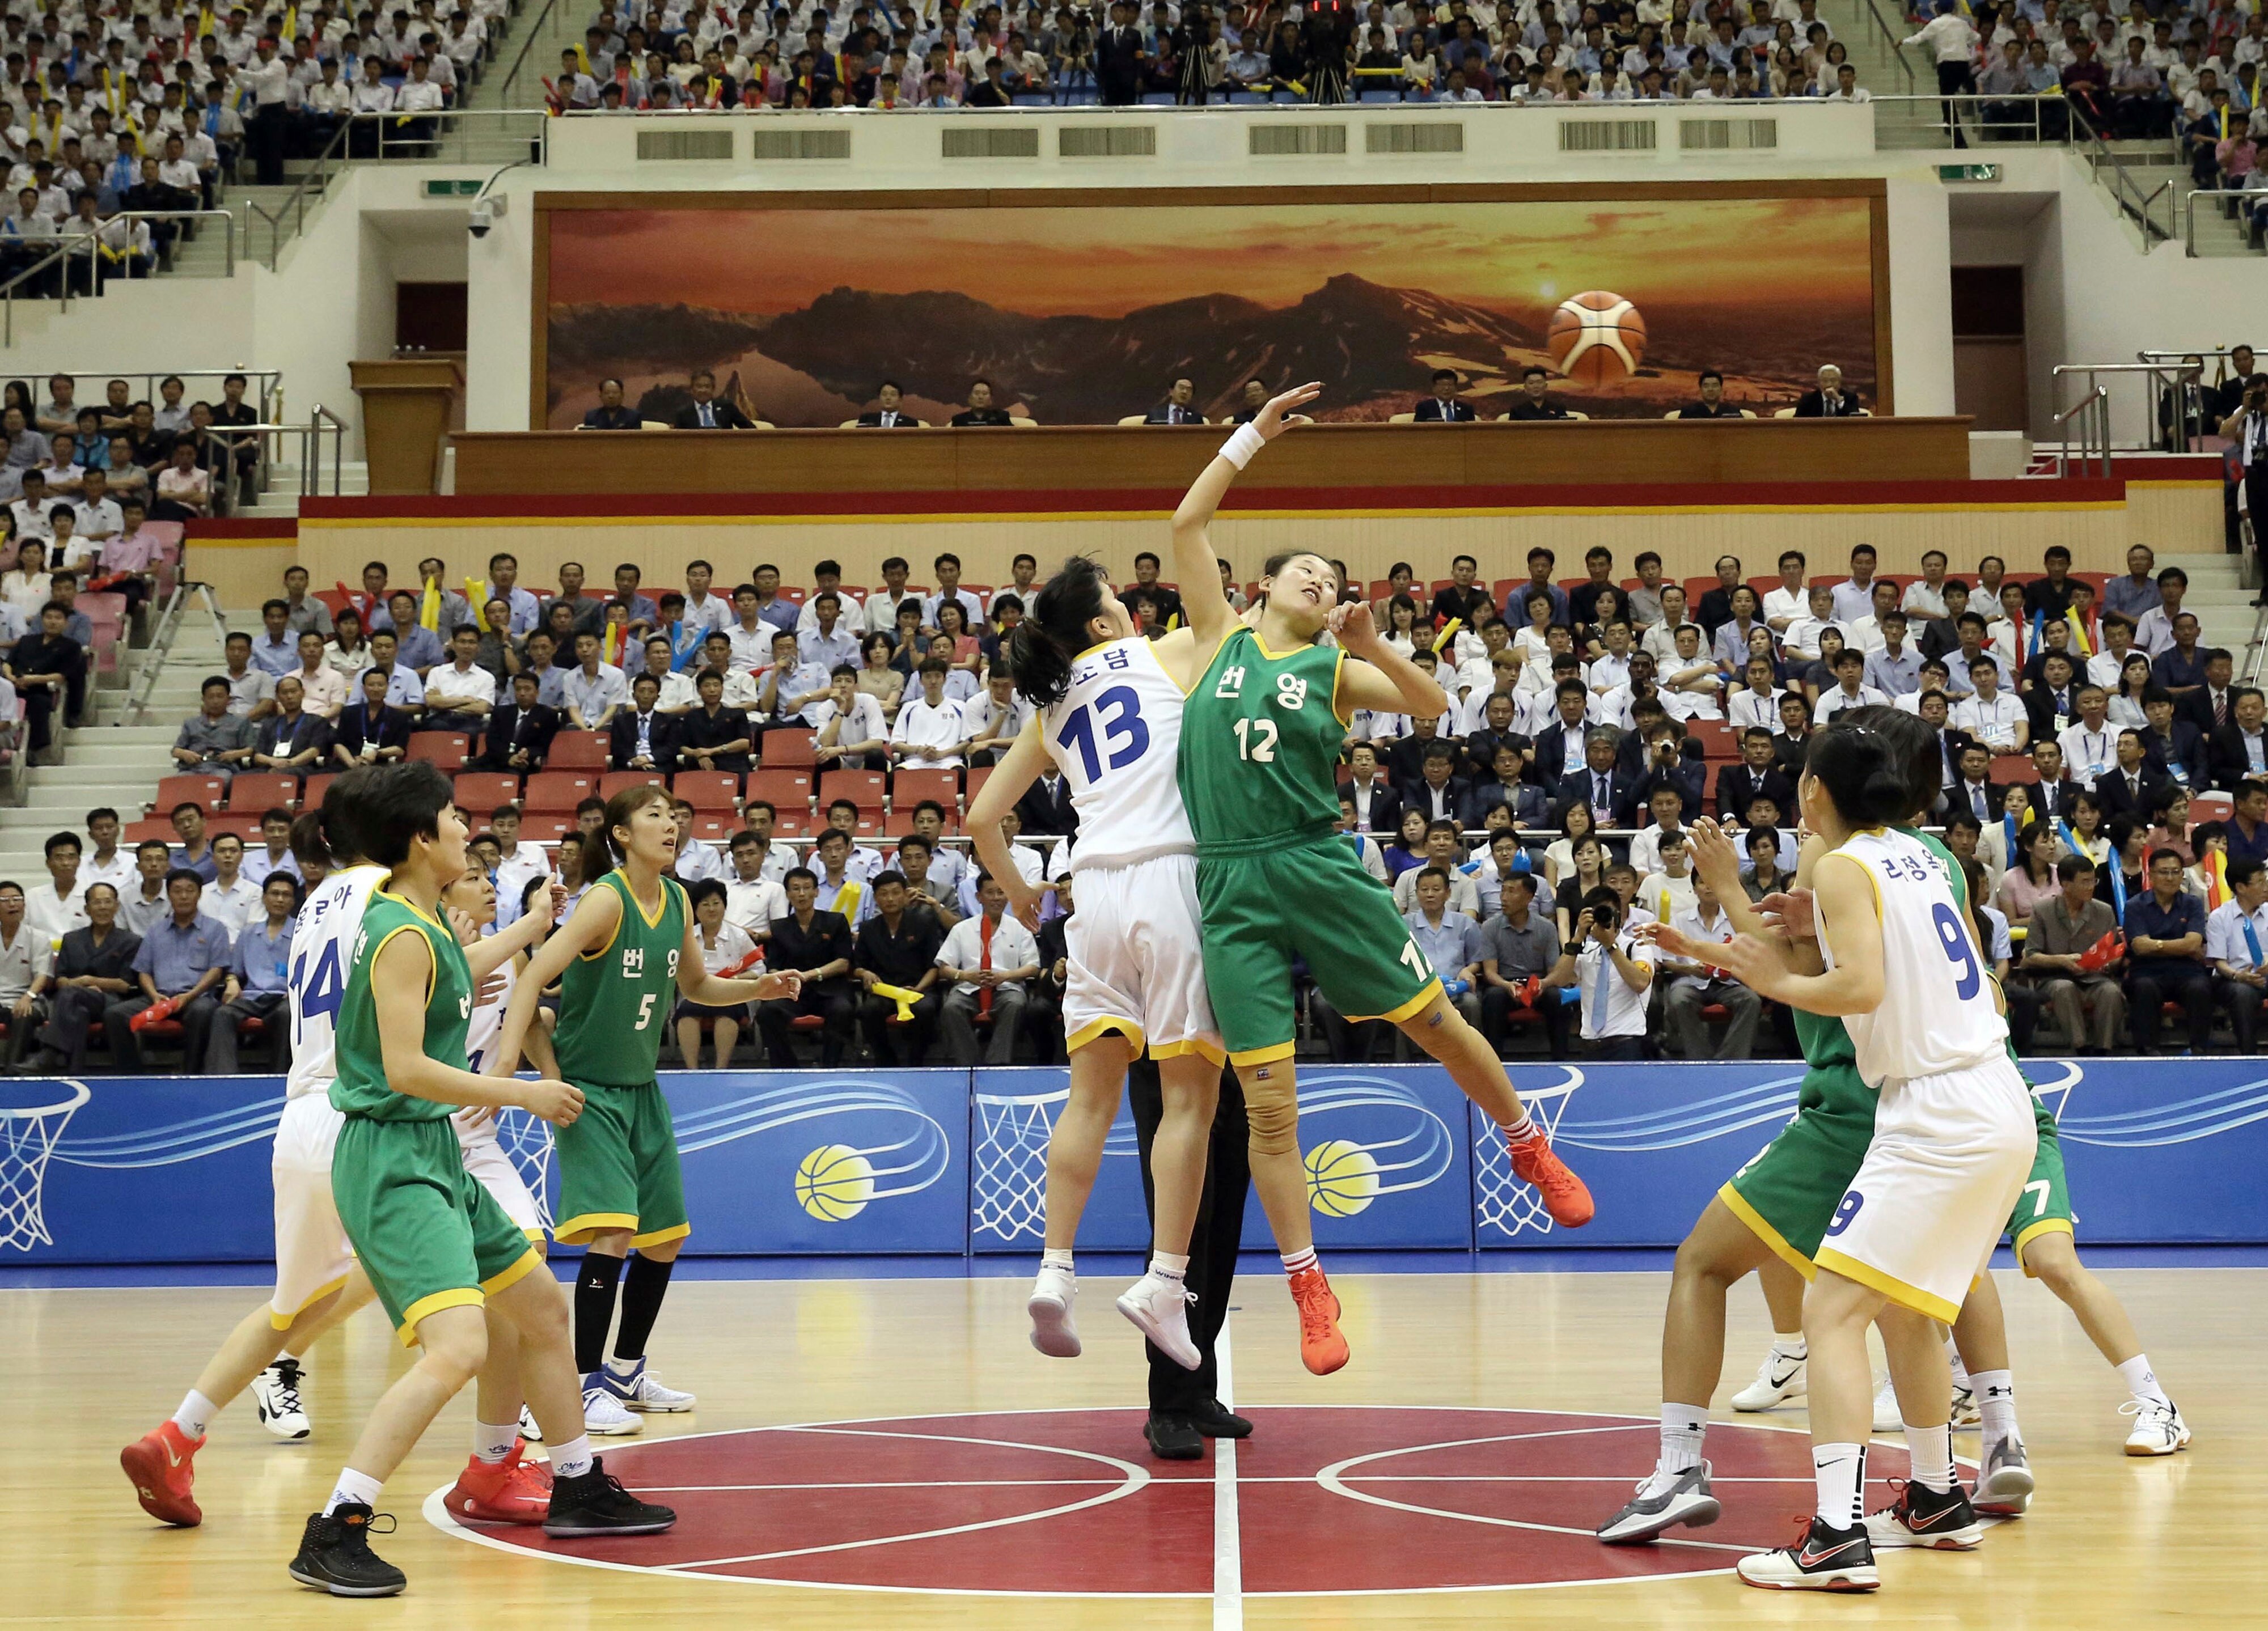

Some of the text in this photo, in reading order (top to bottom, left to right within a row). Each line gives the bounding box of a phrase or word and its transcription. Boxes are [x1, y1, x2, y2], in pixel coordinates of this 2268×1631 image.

[1057, 685, 1150, 785] 13
[1233, 718, 1279, 763] 12
[1399, 930, 1434, 983] 1
[1931, 901, 1981, 1001] 9
[289, 936, 346, 1045] 14
[634, 993, 657, 1031] 5
[1825, 1190, 1865, 1236] 9
[2024, 1179, 2051, 1217] 7
